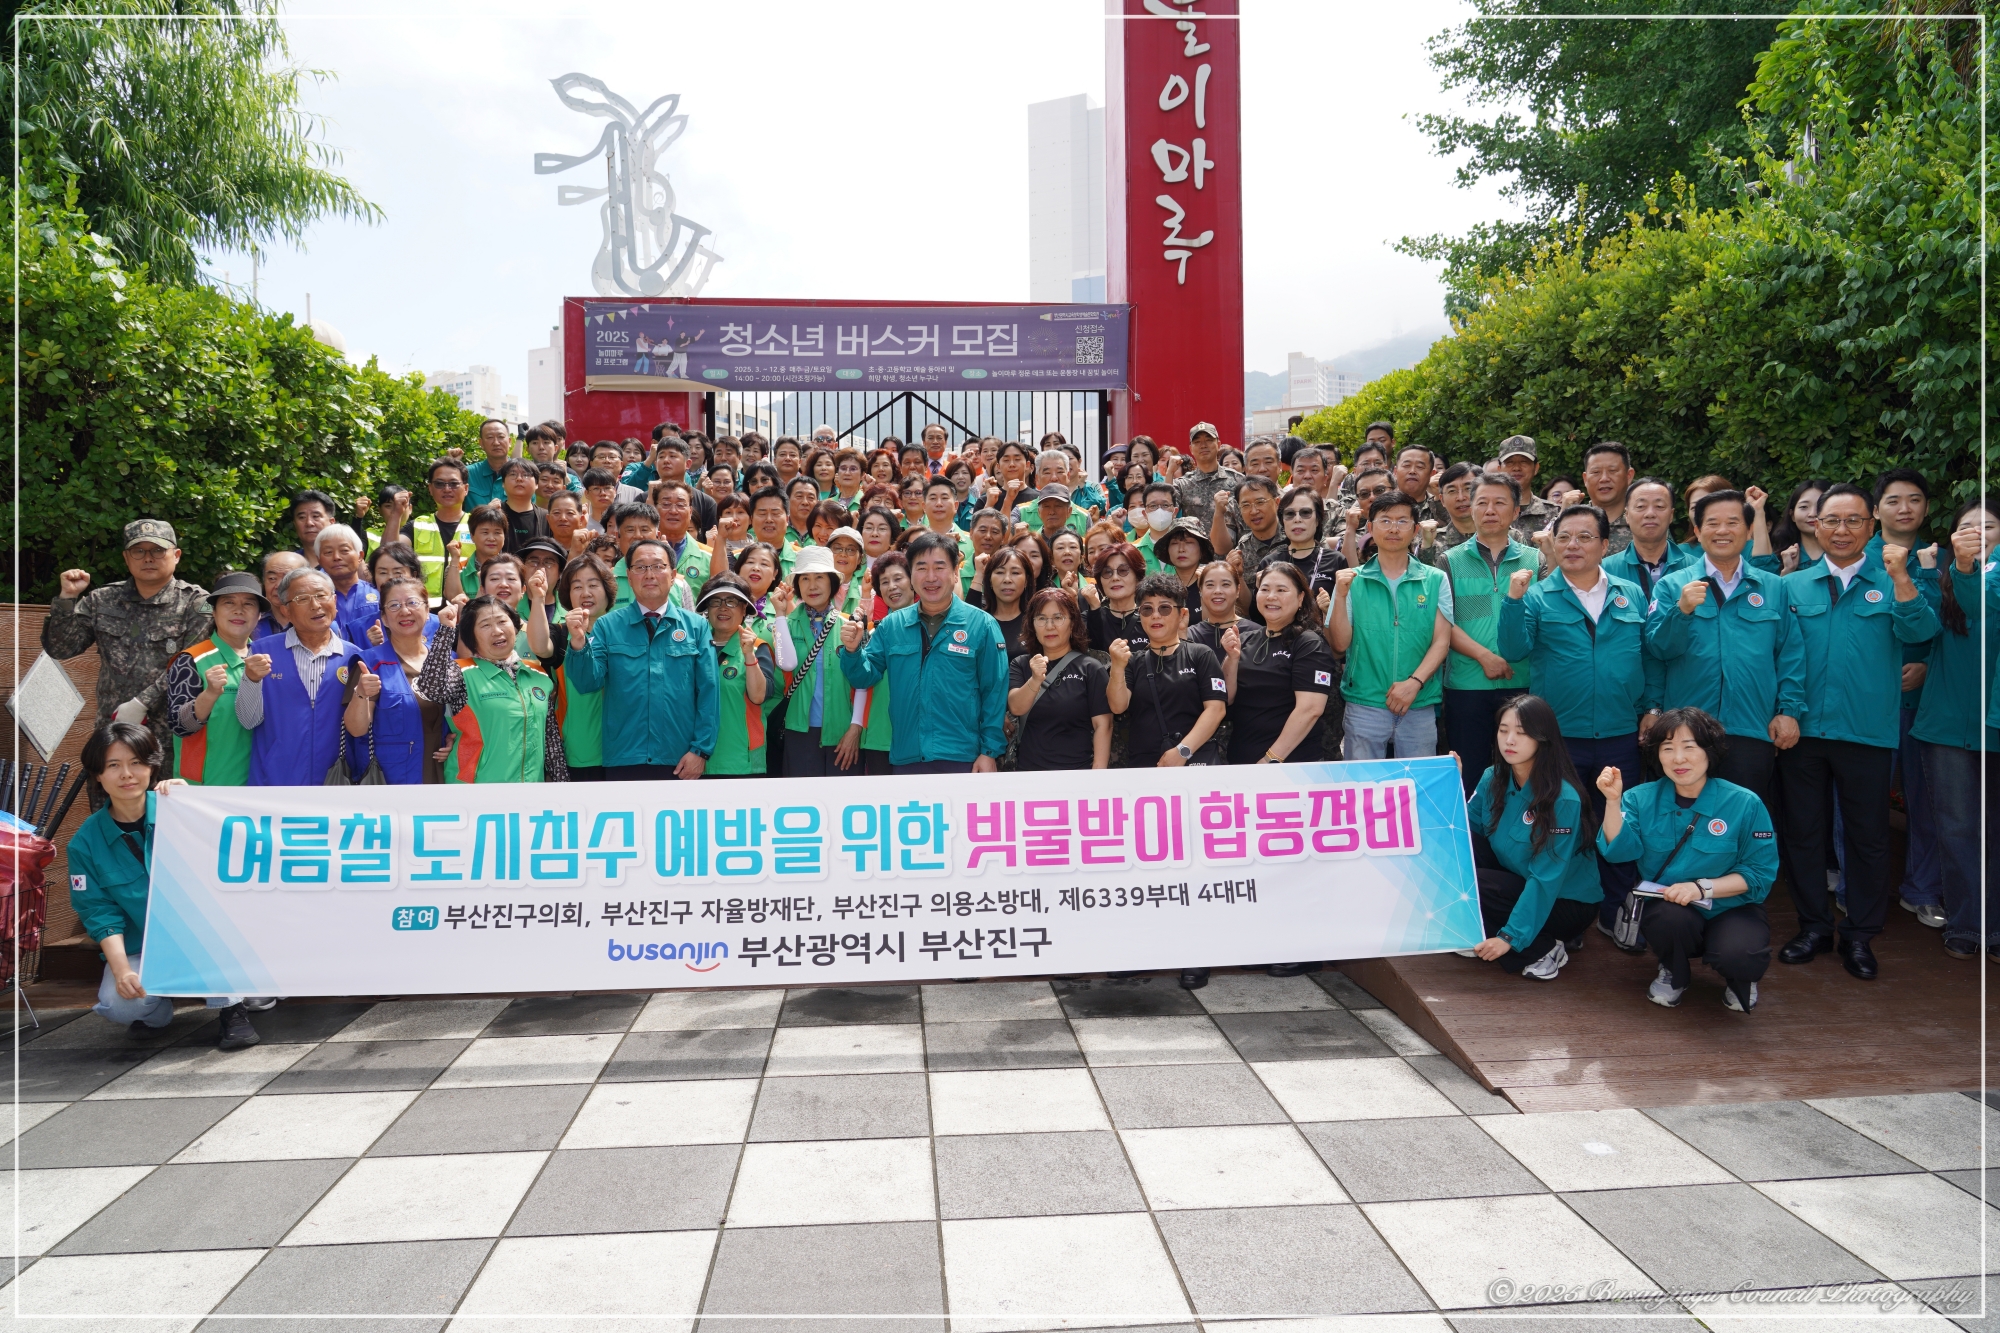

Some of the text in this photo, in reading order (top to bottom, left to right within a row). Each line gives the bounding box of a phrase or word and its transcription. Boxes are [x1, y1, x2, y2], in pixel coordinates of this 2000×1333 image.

[596, 330, 630, 343] 2025
[719, 322, 1019, 358] 청소년 버스커 모집
[1075, 324, 1105, 334] 신청접수
[217, 784, 1416, 884] 여름철 도시침수 예방을 위한 빗물받이 합동정비
[444, 901, 591, 930] 부산진구의회,
[601, 899, 694, 928] 부산진구
[701, 895, 823, 926] 자율방재단,
[832, 892, 923, 920] 부산진구
[930, 887, 1049, 917] 의용소방대,
[1058, 880, 1190, 913] 제6339부대
[1197, 878, 1257, 904] 4대대
[607, 926, 1053, 968] busanjin 부산광역시 부산진구
